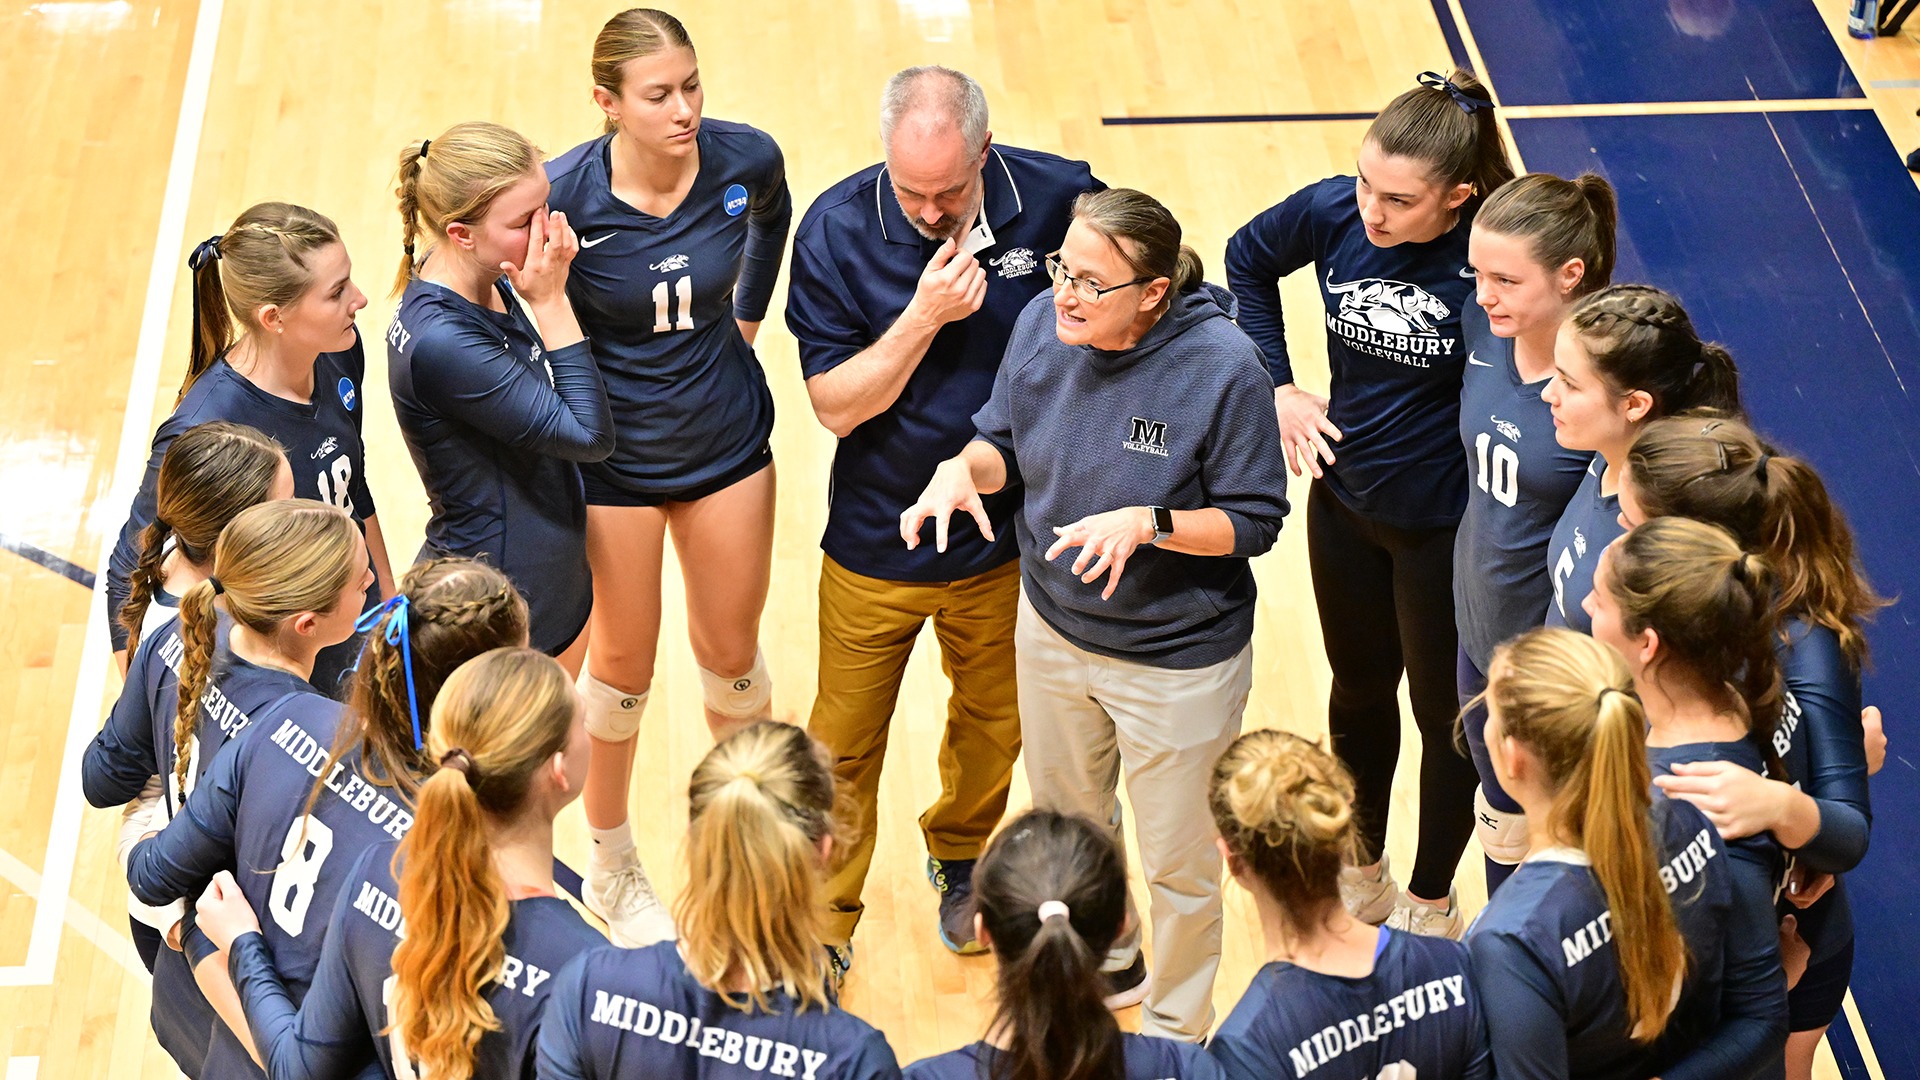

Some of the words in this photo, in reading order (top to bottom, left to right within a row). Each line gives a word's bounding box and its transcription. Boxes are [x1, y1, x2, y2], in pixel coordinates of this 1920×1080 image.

[727, 196, 747, 210] NCAA
[652, 275, 694, 333] 11
[1326, 312, 1456, 356] MIDDLEBURY
[1341, 338, 1430, 368] VOLLEYBALL
[1122, 440, 1169, 457] VOLLEYBALL
[1129, 416, 1167, 448] M
[1475, 432, 1520, 508] 10
[270, 718, 415, 840] MIDDLEBUR
[268, 813, 333, 938] 8
[591, 989, 827, 1080] MIDDLEBURY
